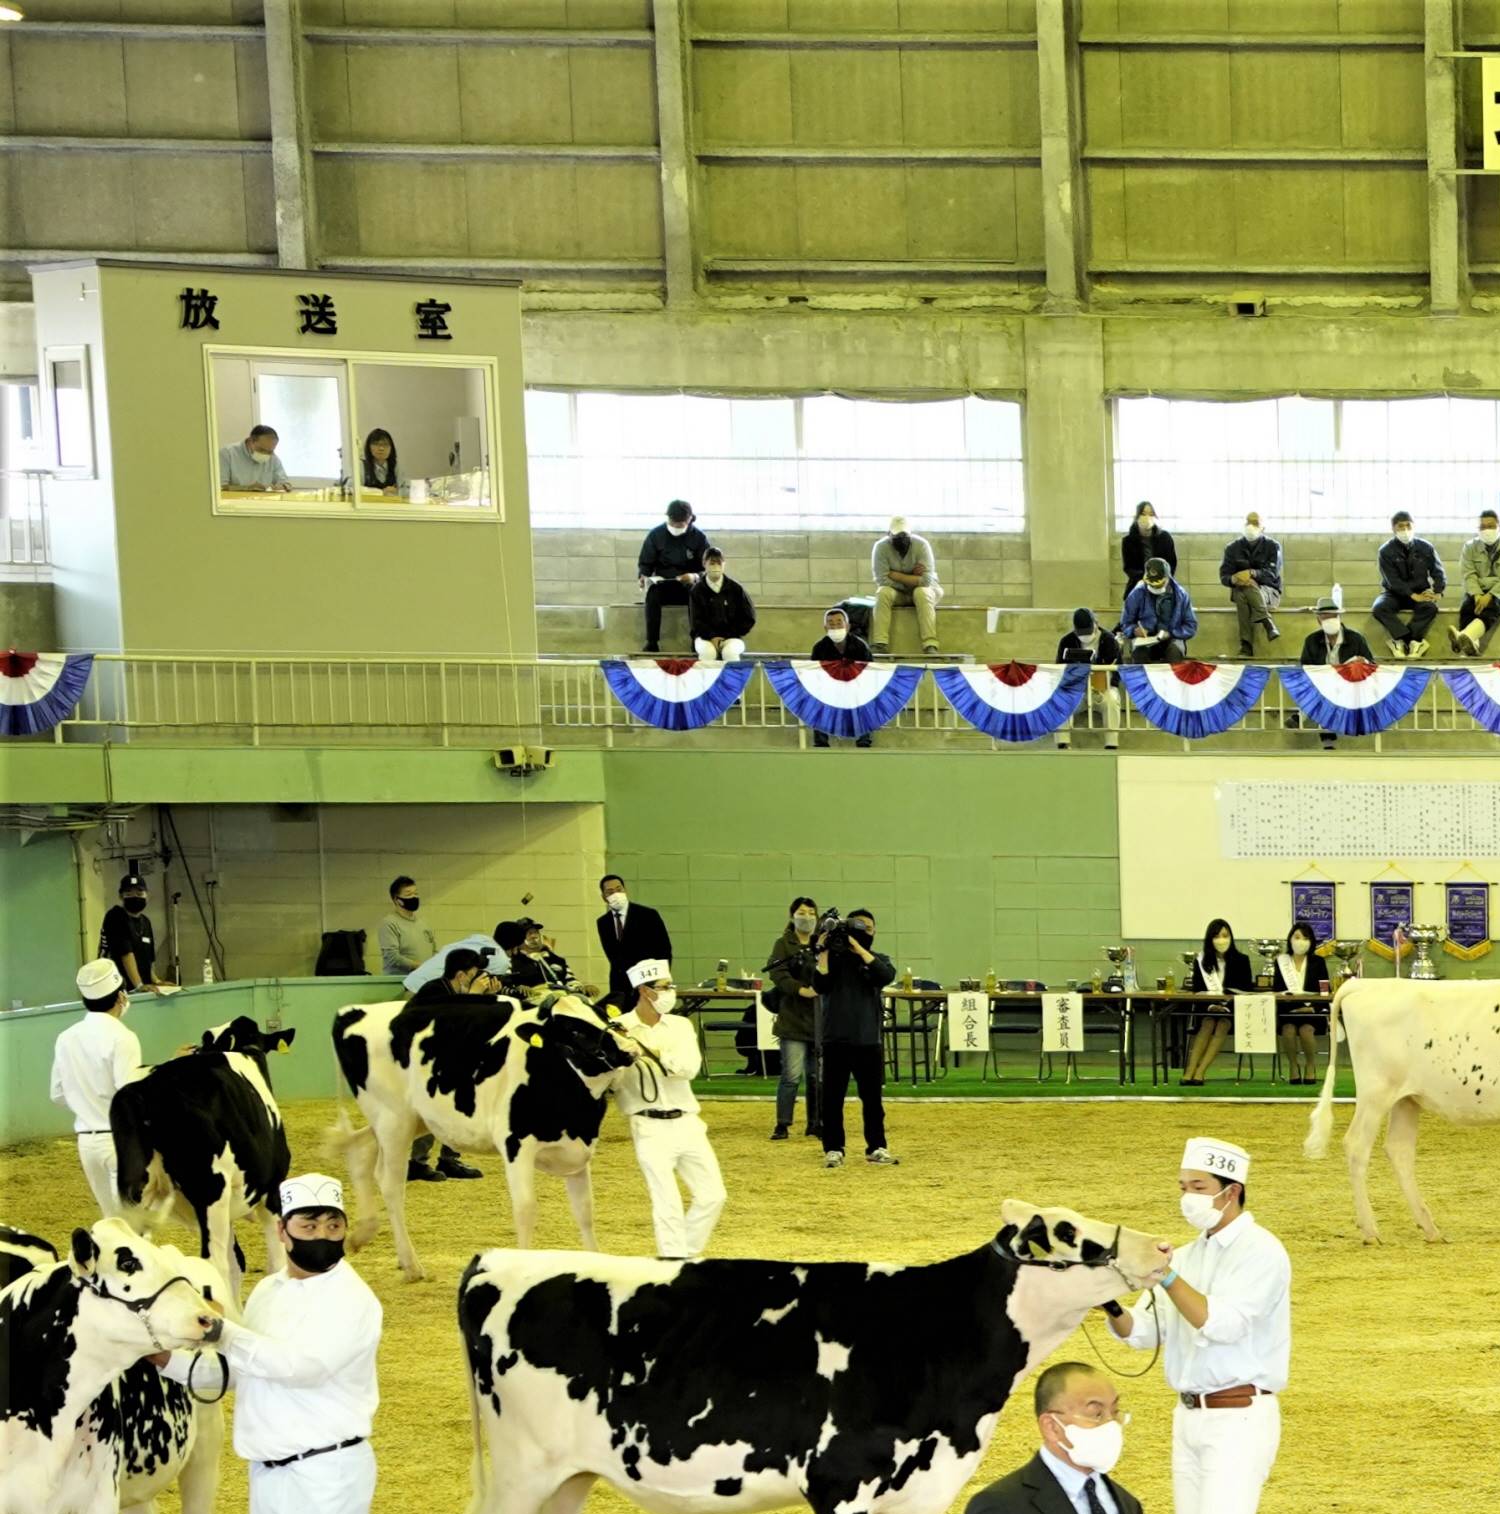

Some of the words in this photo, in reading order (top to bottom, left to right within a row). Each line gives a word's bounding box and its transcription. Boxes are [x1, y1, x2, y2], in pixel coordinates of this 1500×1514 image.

[179, 287, 453, 340] 放送室
[640, 967, 659, 979] 347
[960, 997, 978, 1048] 組合長
[1055, 996, 1071, 1049] 審査員
[1203, 1152, 1237, 1173] 336
